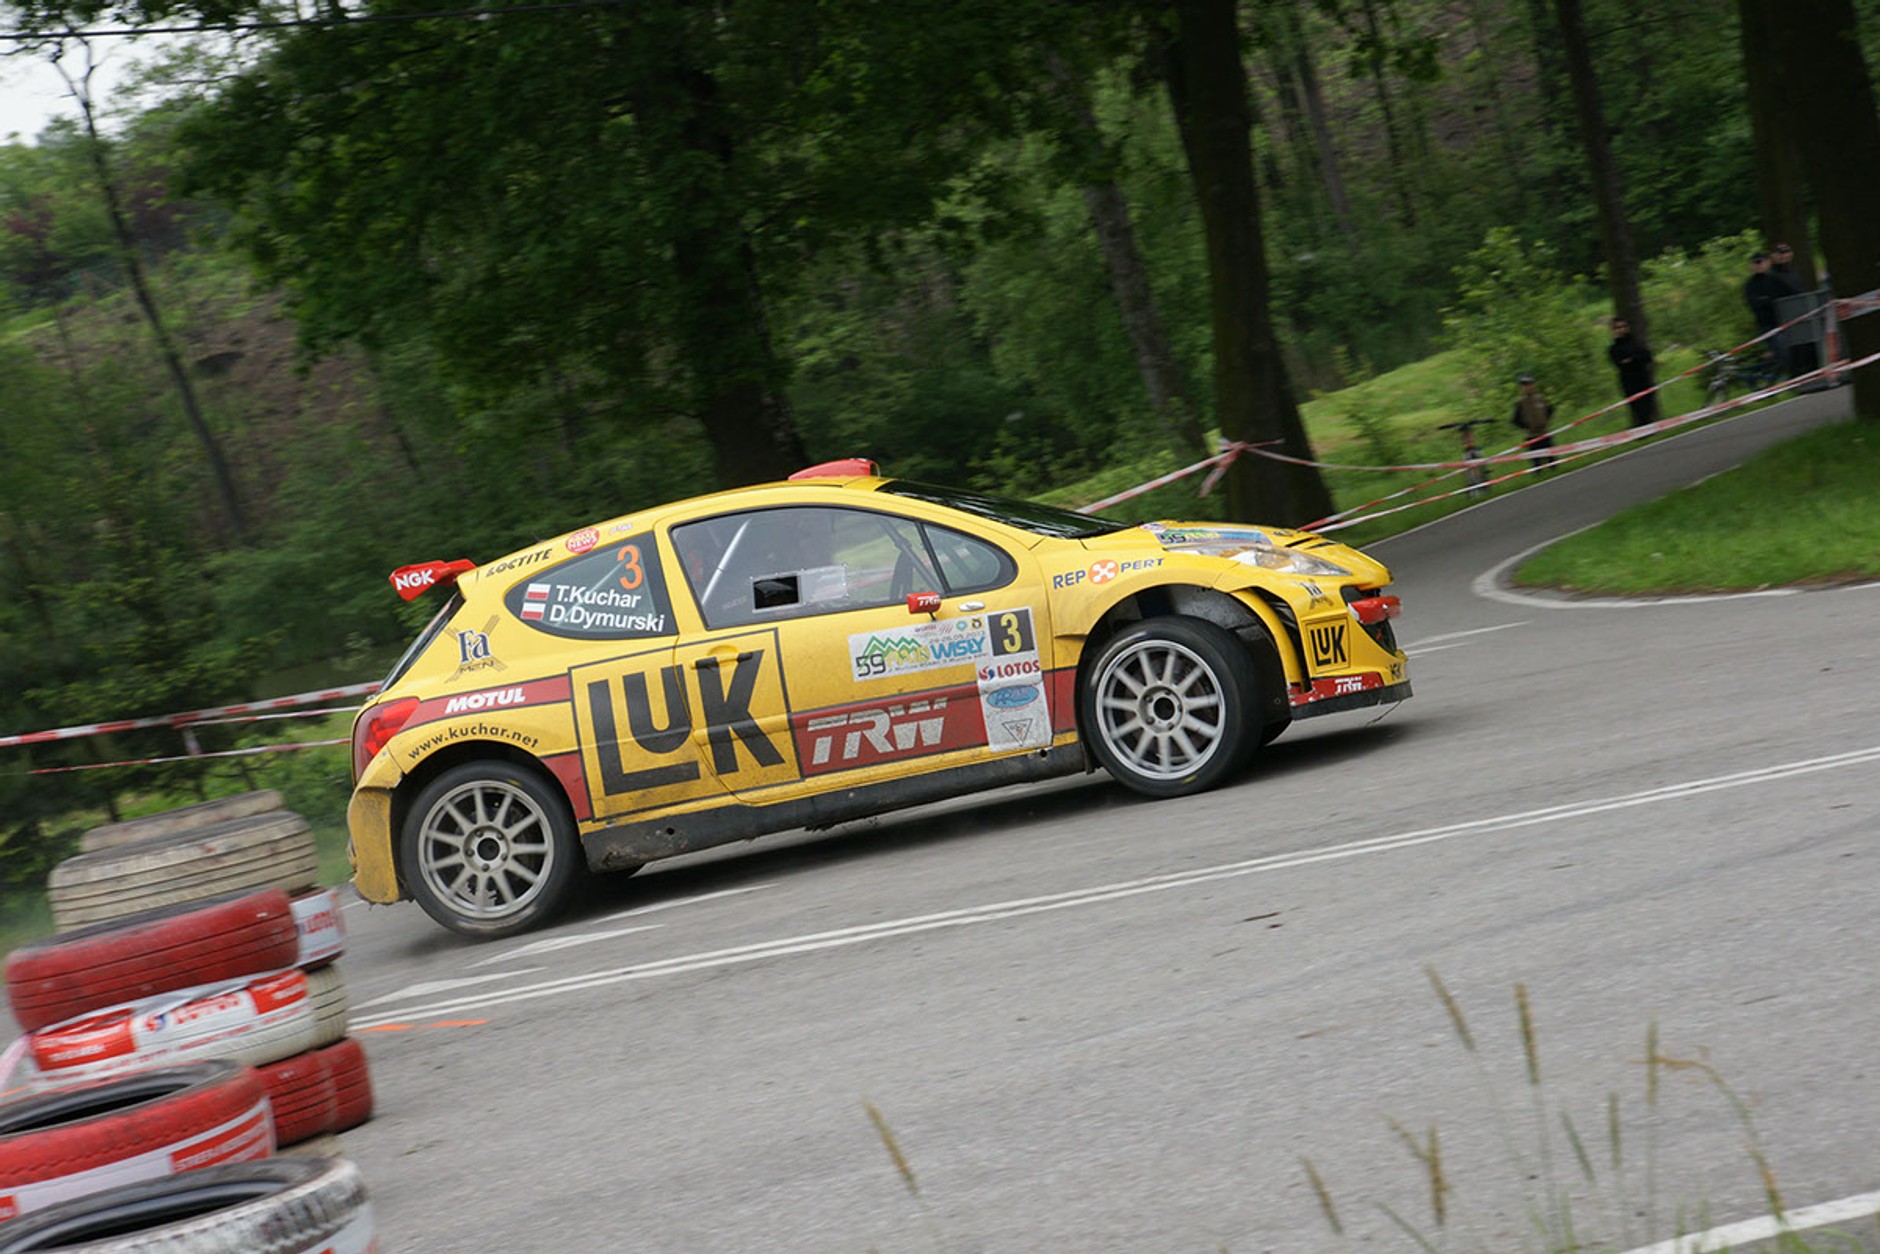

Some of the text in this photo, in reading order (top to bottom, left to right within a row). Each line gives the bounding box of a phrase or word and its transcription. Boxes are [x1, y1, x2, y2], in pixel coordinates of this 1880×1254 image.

[485, 549, 552, 577] LOCTITE
[617, 545, 643, 589] 3
[395, 569, 435, 590] NGK
[556, 585, 641, 608] T.Kuchar
[550, 604, 664, 632] D.Dymurski
[458, 630, 492, 663] Fa
[1001, 613, 1022, 653] 3
[855, 653, 886, 677] 59
[997, 660, 1040, 678] LOTOS
[1335, 676, 1362, 692] TRW
[445, 688, 526, 714] MOTUL
[408, 722, 538, 759] www.kuchar.net
[807, 697, 948, 764] TRW
